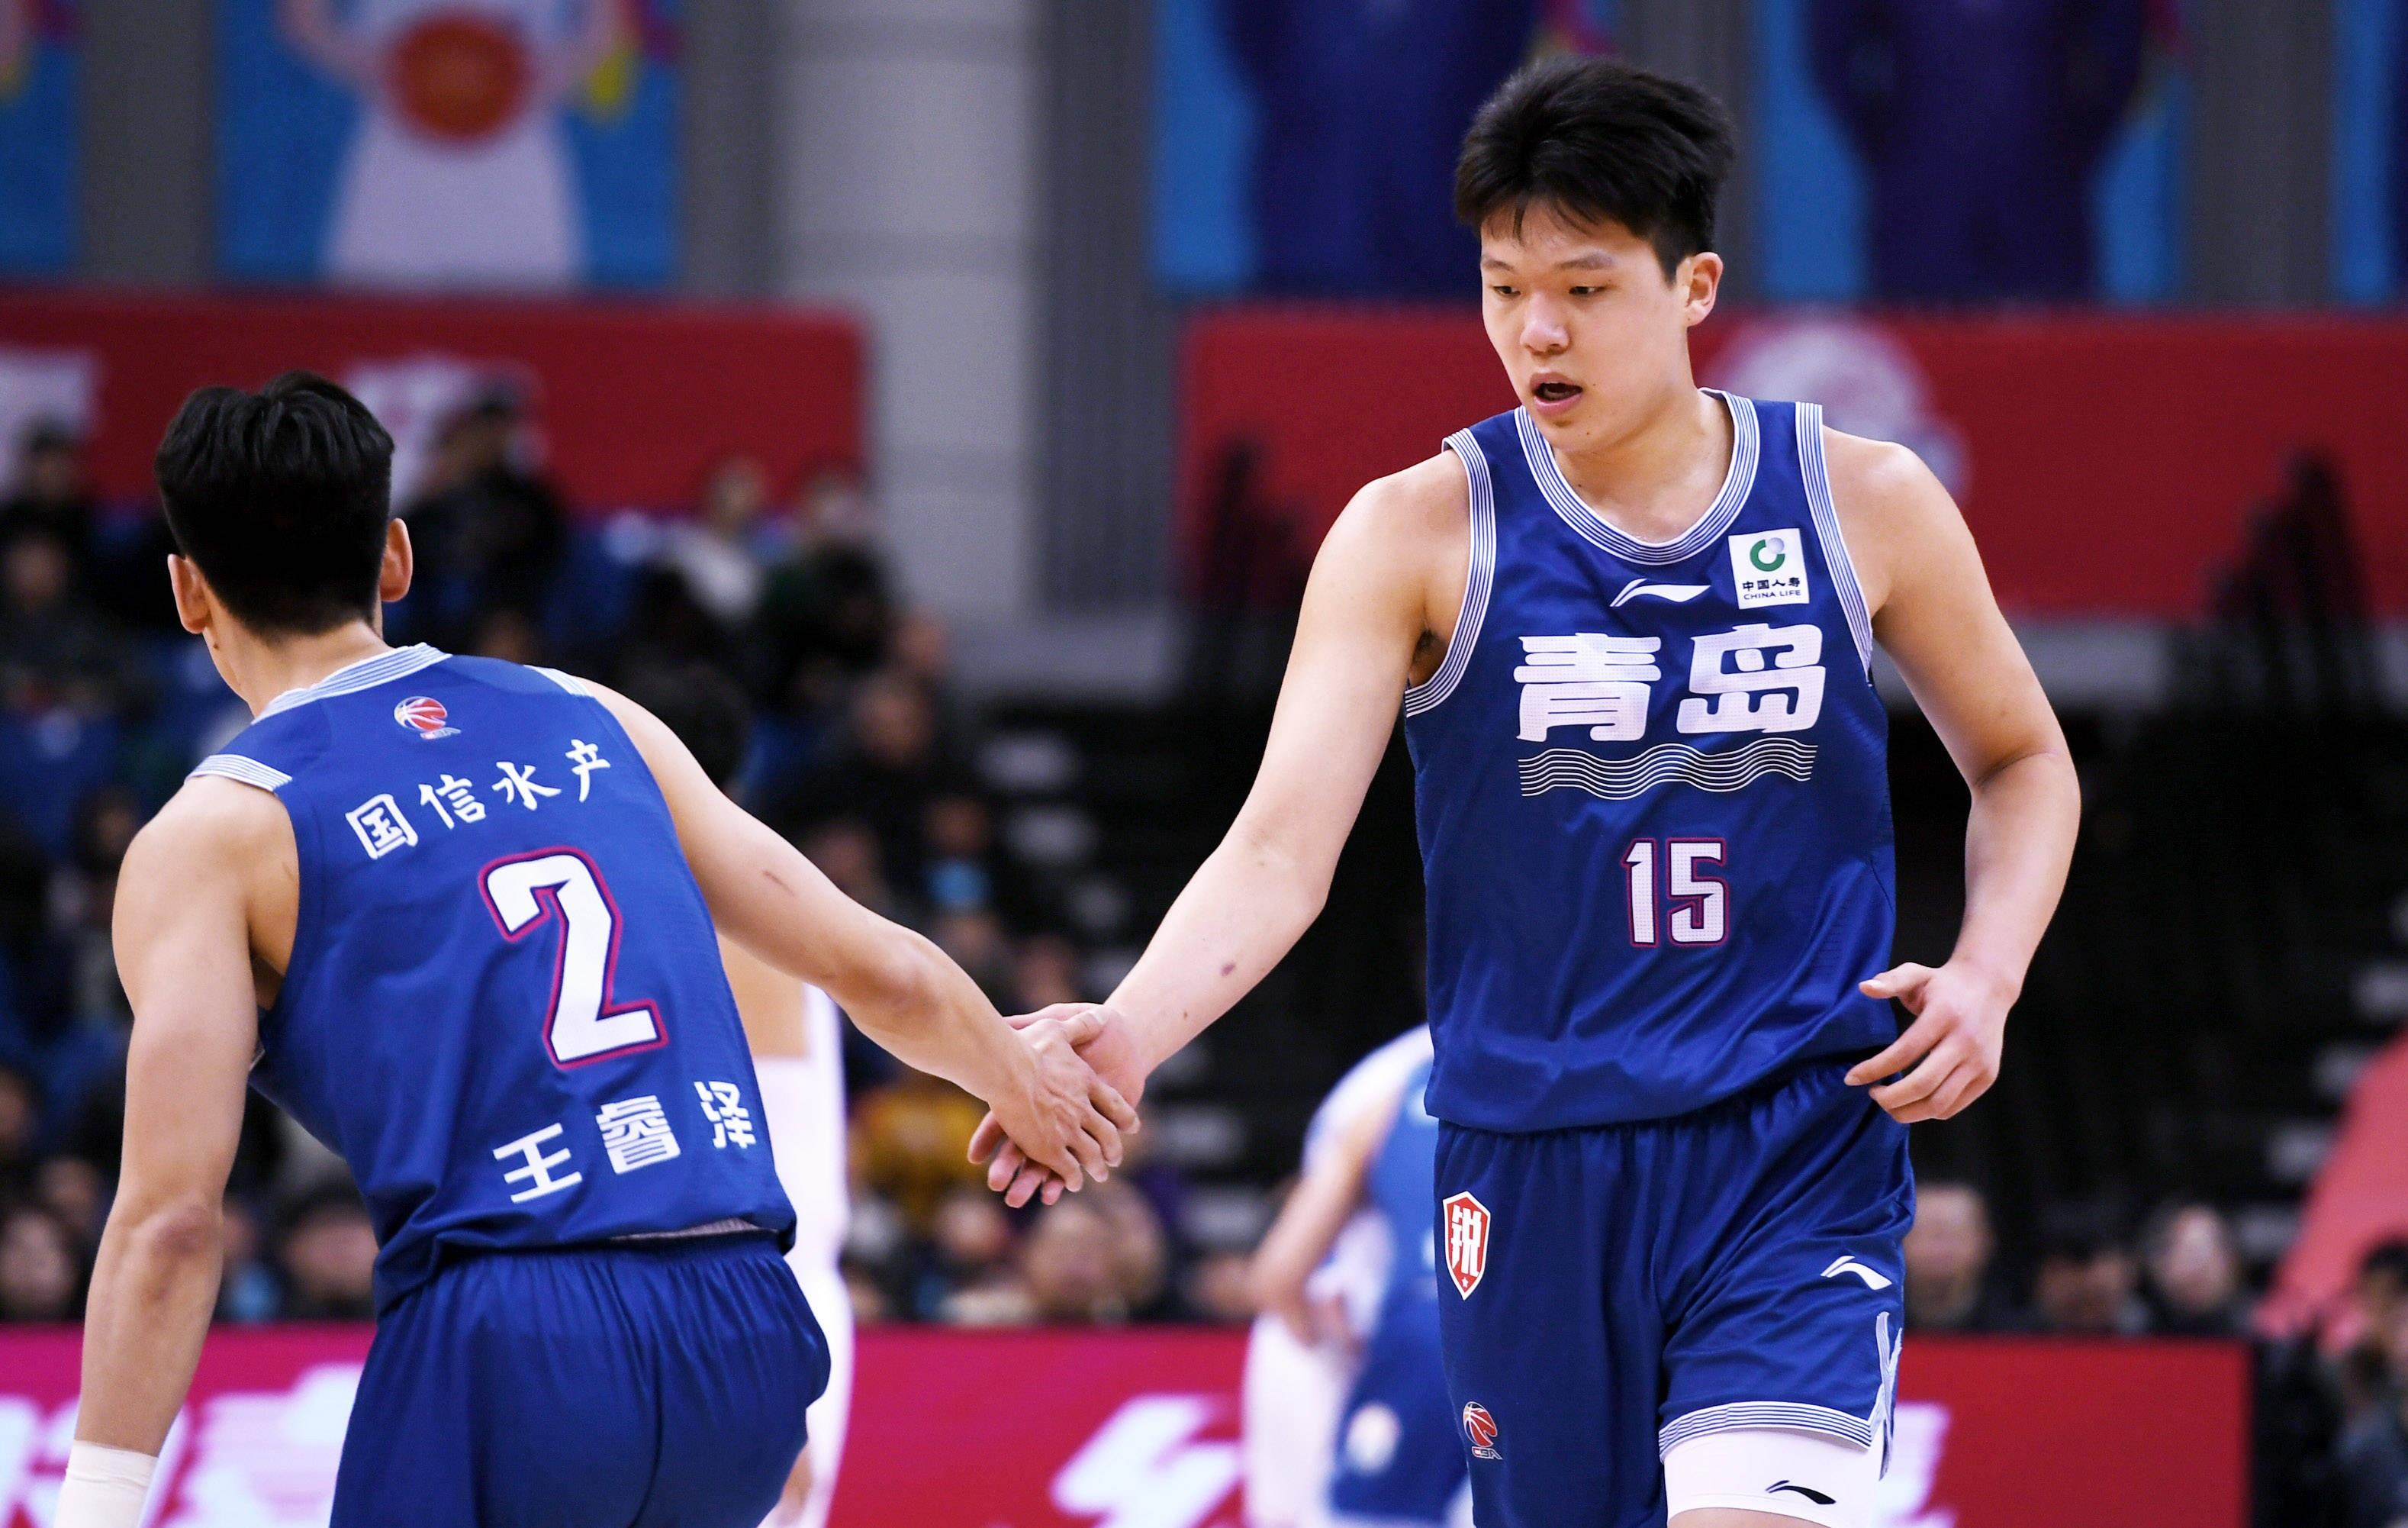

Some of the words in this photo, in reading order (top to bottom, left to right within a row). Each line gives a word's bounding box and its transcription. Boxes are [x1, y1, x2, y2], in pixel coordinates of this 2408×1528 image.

[1742, 577, 1800, 592] 中国人寿
[1743, 592, 1776, 600] CHINA
[1513, 623, 1826, 742] 青岛
[344, 738, 611, 860] 国信水产
[1621, 837, 1729, 948] 15
[478, 846, 669, 1070] 2
[492, 1080, 758, 1204] 王睿泽
[1472, 1446, 1502, 1460] CBA
